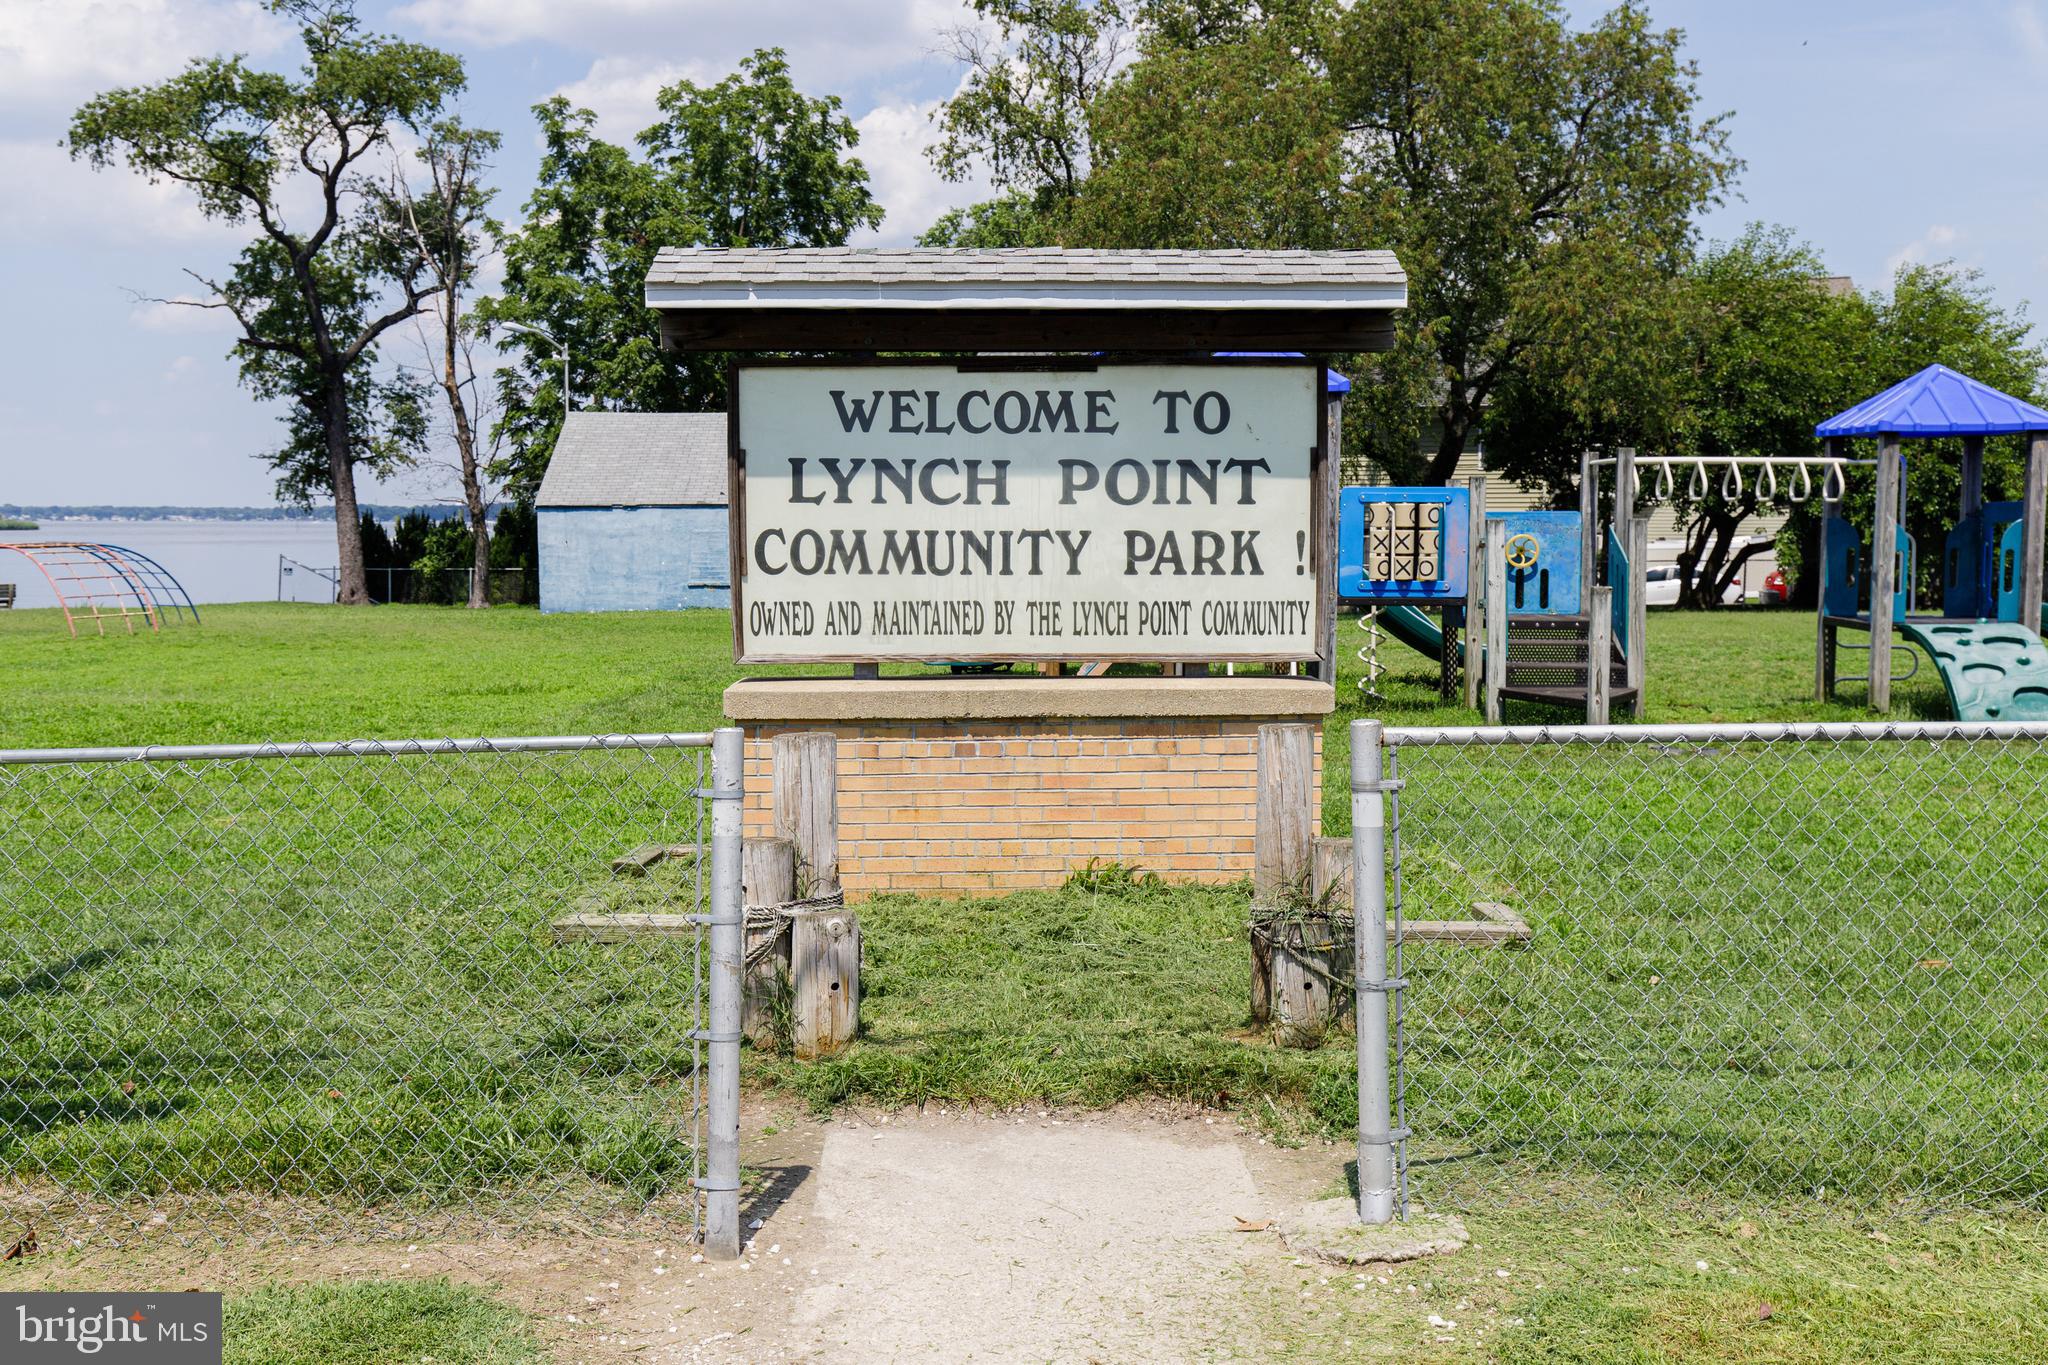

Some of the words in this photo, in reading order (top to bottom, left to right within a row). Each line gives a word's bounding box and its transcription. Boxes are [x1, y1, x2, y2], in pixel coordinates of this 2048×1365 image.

[829, 389, 1120, 435] WELCOME
[1152, 390, 1231, 435] TO
[788, 457, 1012, 506] LYNCH
[1058, 457, 1272, 506] POINT
[754, 528, 1092, 576] COMMUNITY
[1124, 530, 1264, 576] PARK
[750, 600, 814, 636] OWNED
[825, 601, 862, 635] AND
[873, 600, 985, 635] MAINTAINED
[995, 600, 1016, 635] BY
[1026, 601, 1063, 636] THE
[1073, 601, 1128, 636] LYNCH
[1139, 601, 1192, 636] POINT
[1203, 600, 1310, 636] COMMUNITY
